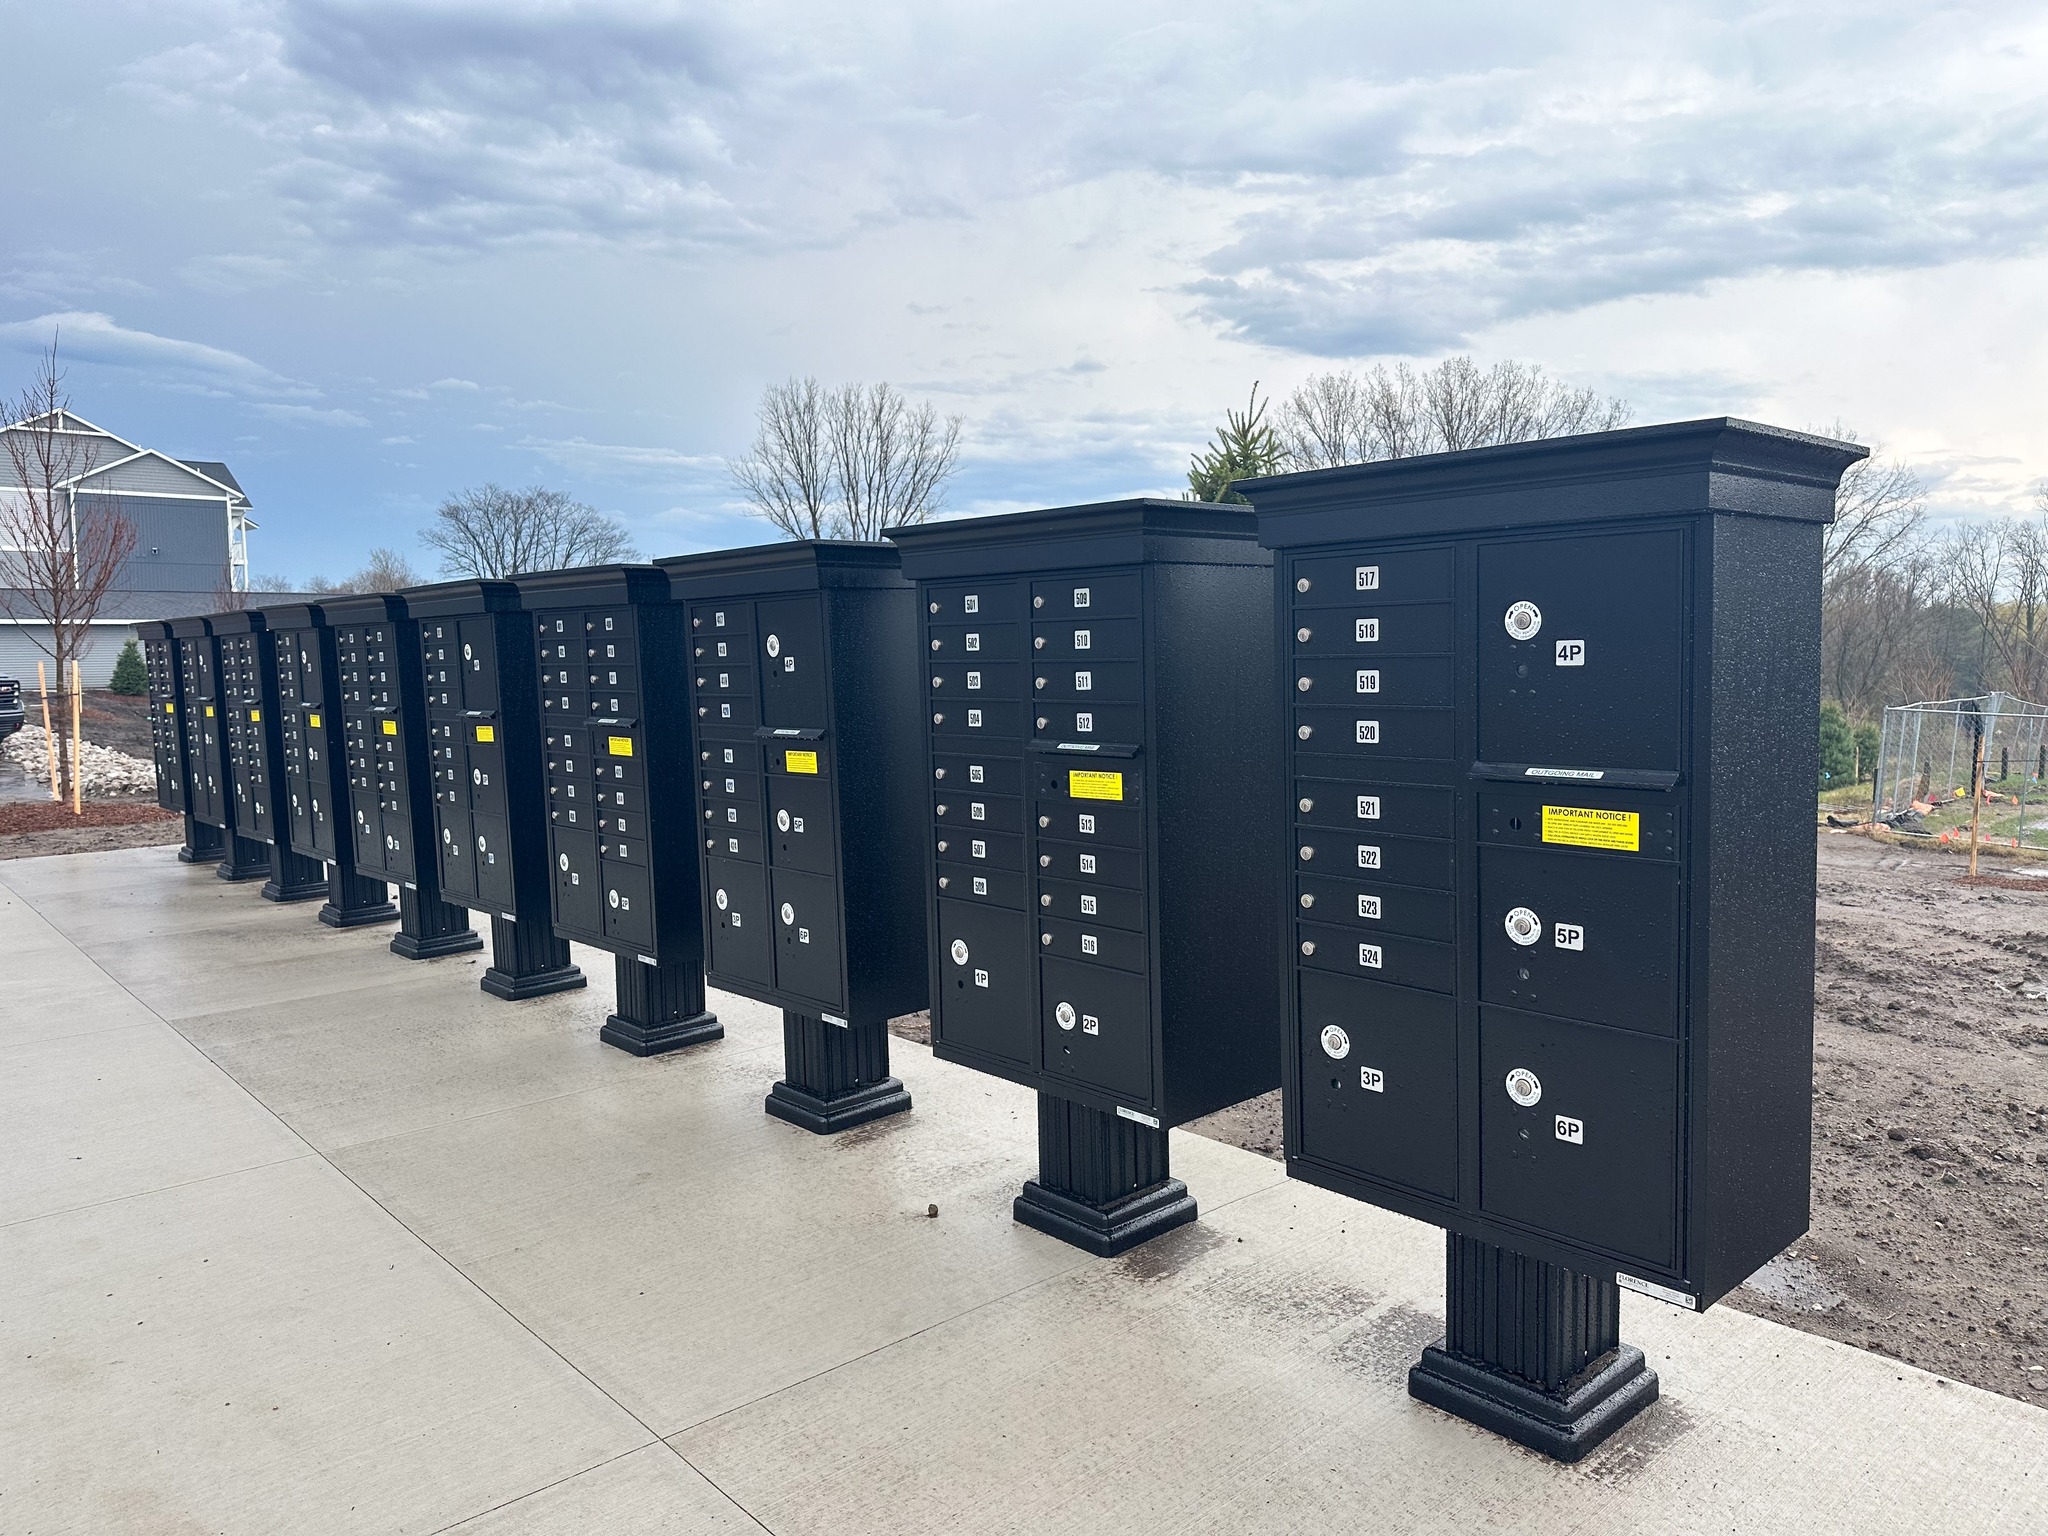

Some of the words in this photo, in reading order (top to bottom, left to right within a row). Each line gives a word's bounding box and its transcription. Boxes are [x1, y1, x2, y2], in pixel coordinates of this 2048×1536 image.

[1358, 571, 1375, 587] 517
[966, 599, 976, 611] 501
[1076, 592, 1088, 605] 509
[1358, 623, 1375, 639] 518
[967, 637, 978, 649] 502
[1076, 634, 1088, 647] 510
[1557, 644, 1582, 661] 4P
[785, 660, 793, 669] 4P
[1077, 675, 1088, 688] 511
[1359, 675, 1376, 690] 519
[970, 713, 980, 725] 504
[1078, 717, 1090, 729] 512
[1359, 725, 1376, 740] 520
[1360, 800, 1375, 816] 521
[1548, 808, 1594, 818] IMPORTANT
[1596, 812, 1626, 821] NOTICE
[794, 820, 802, 829] 5P
[1081, 818, 1092, 831] 513
[974, 844, 984, 855] 507
[1082, 858, 1093, 871] 514
[1360, 850, 1377, 866] 522
[1082, 899, 1094, 912] 515
[1361, 899, 1377, 916] 523
[1514, 910, 1534, 918] OPEN
[1557, 928, 1580, 945] 5P
[1084, 938, 1095, 952] 516
[1362, 948, 1379, 965] 524
[976, 972, 987, 984] 1P
[1083, 1018, 1097, 1031] 2P
[1329, 1026, 1344, 1037] OPEN
[1362, 1071, 1381, 1087] 3P
[1515, 1070, 1534, 1080] OPEN
[1557, 1120, 1580, 1138] 6P
